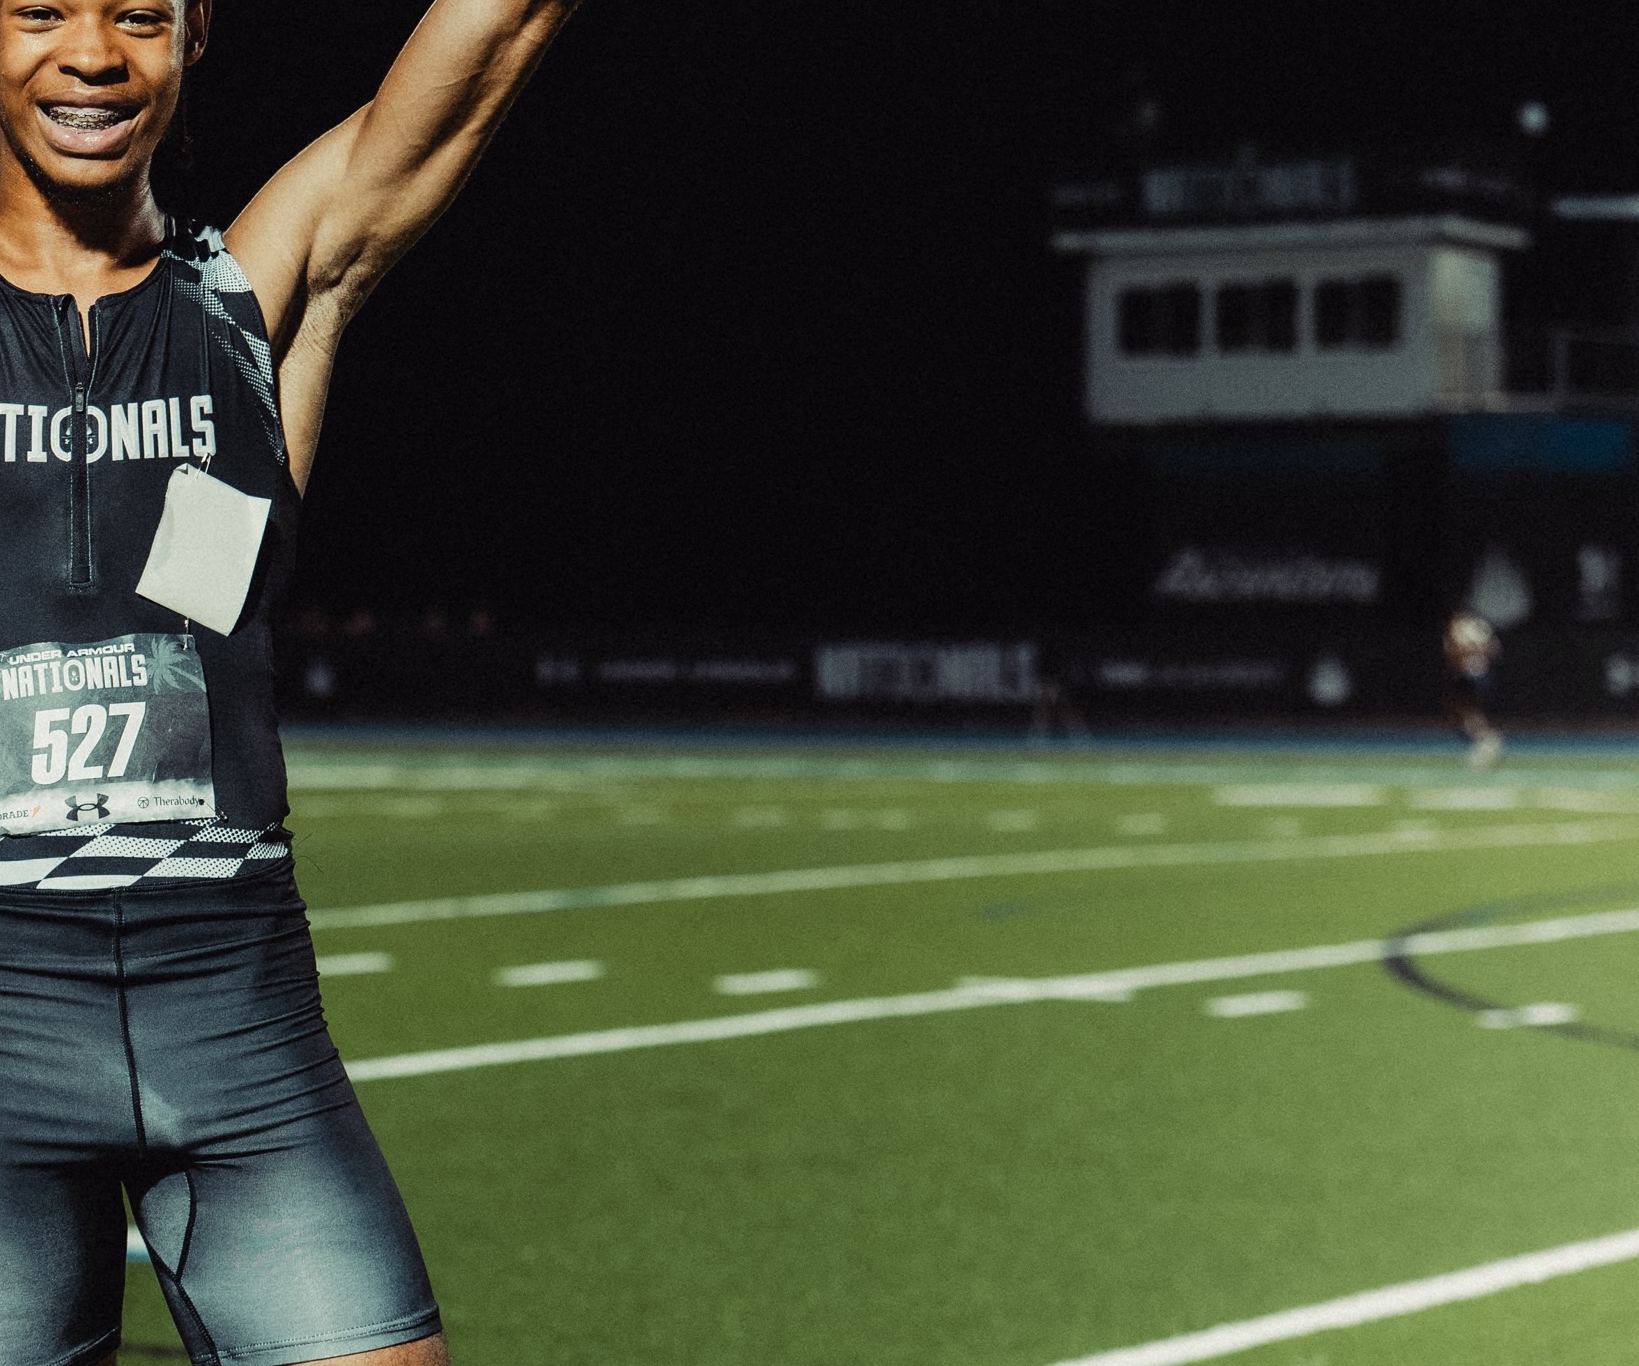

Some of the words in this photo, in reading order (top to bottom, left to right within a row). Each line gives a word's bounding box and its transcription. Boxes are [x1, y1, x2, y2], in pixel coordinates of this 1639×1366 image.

[9, 649, 62, 665] UNDER
[66, 643, 135, 658] ARMOUR
[1, 654, 148, 701] NATIONALS
[31, 701, 147, 785] 527
[152, 794, 200, 808] Therabody
